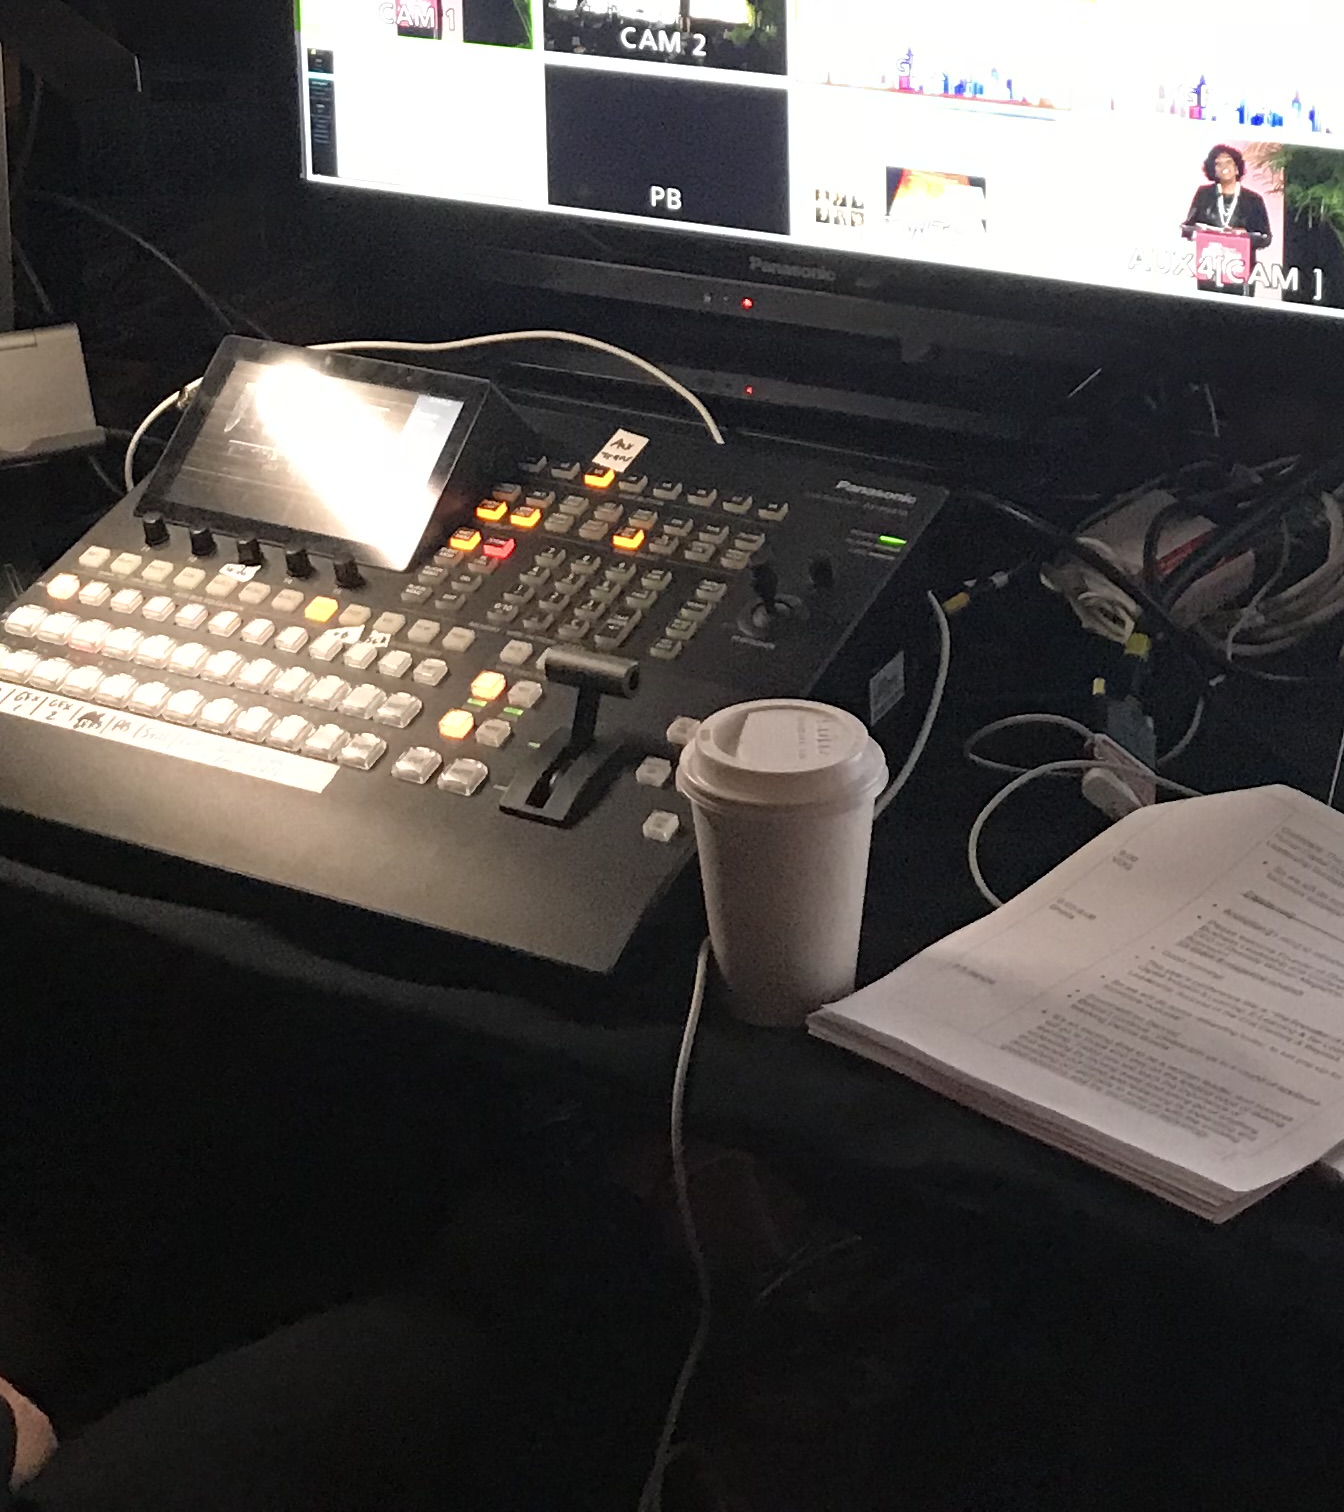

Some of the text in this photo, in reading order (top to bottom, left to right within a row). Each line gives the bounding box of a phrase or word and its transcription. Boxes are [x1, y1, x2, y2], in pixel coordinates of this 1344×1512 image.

[378, 1, 456, 32] CAM 1
[620, 26, 707, 57] CAM 2
[650, 185, 683, 211] PB
[749, 256, 837, 282] Panasonic
[835, 479, 918, 505] Panasonic
